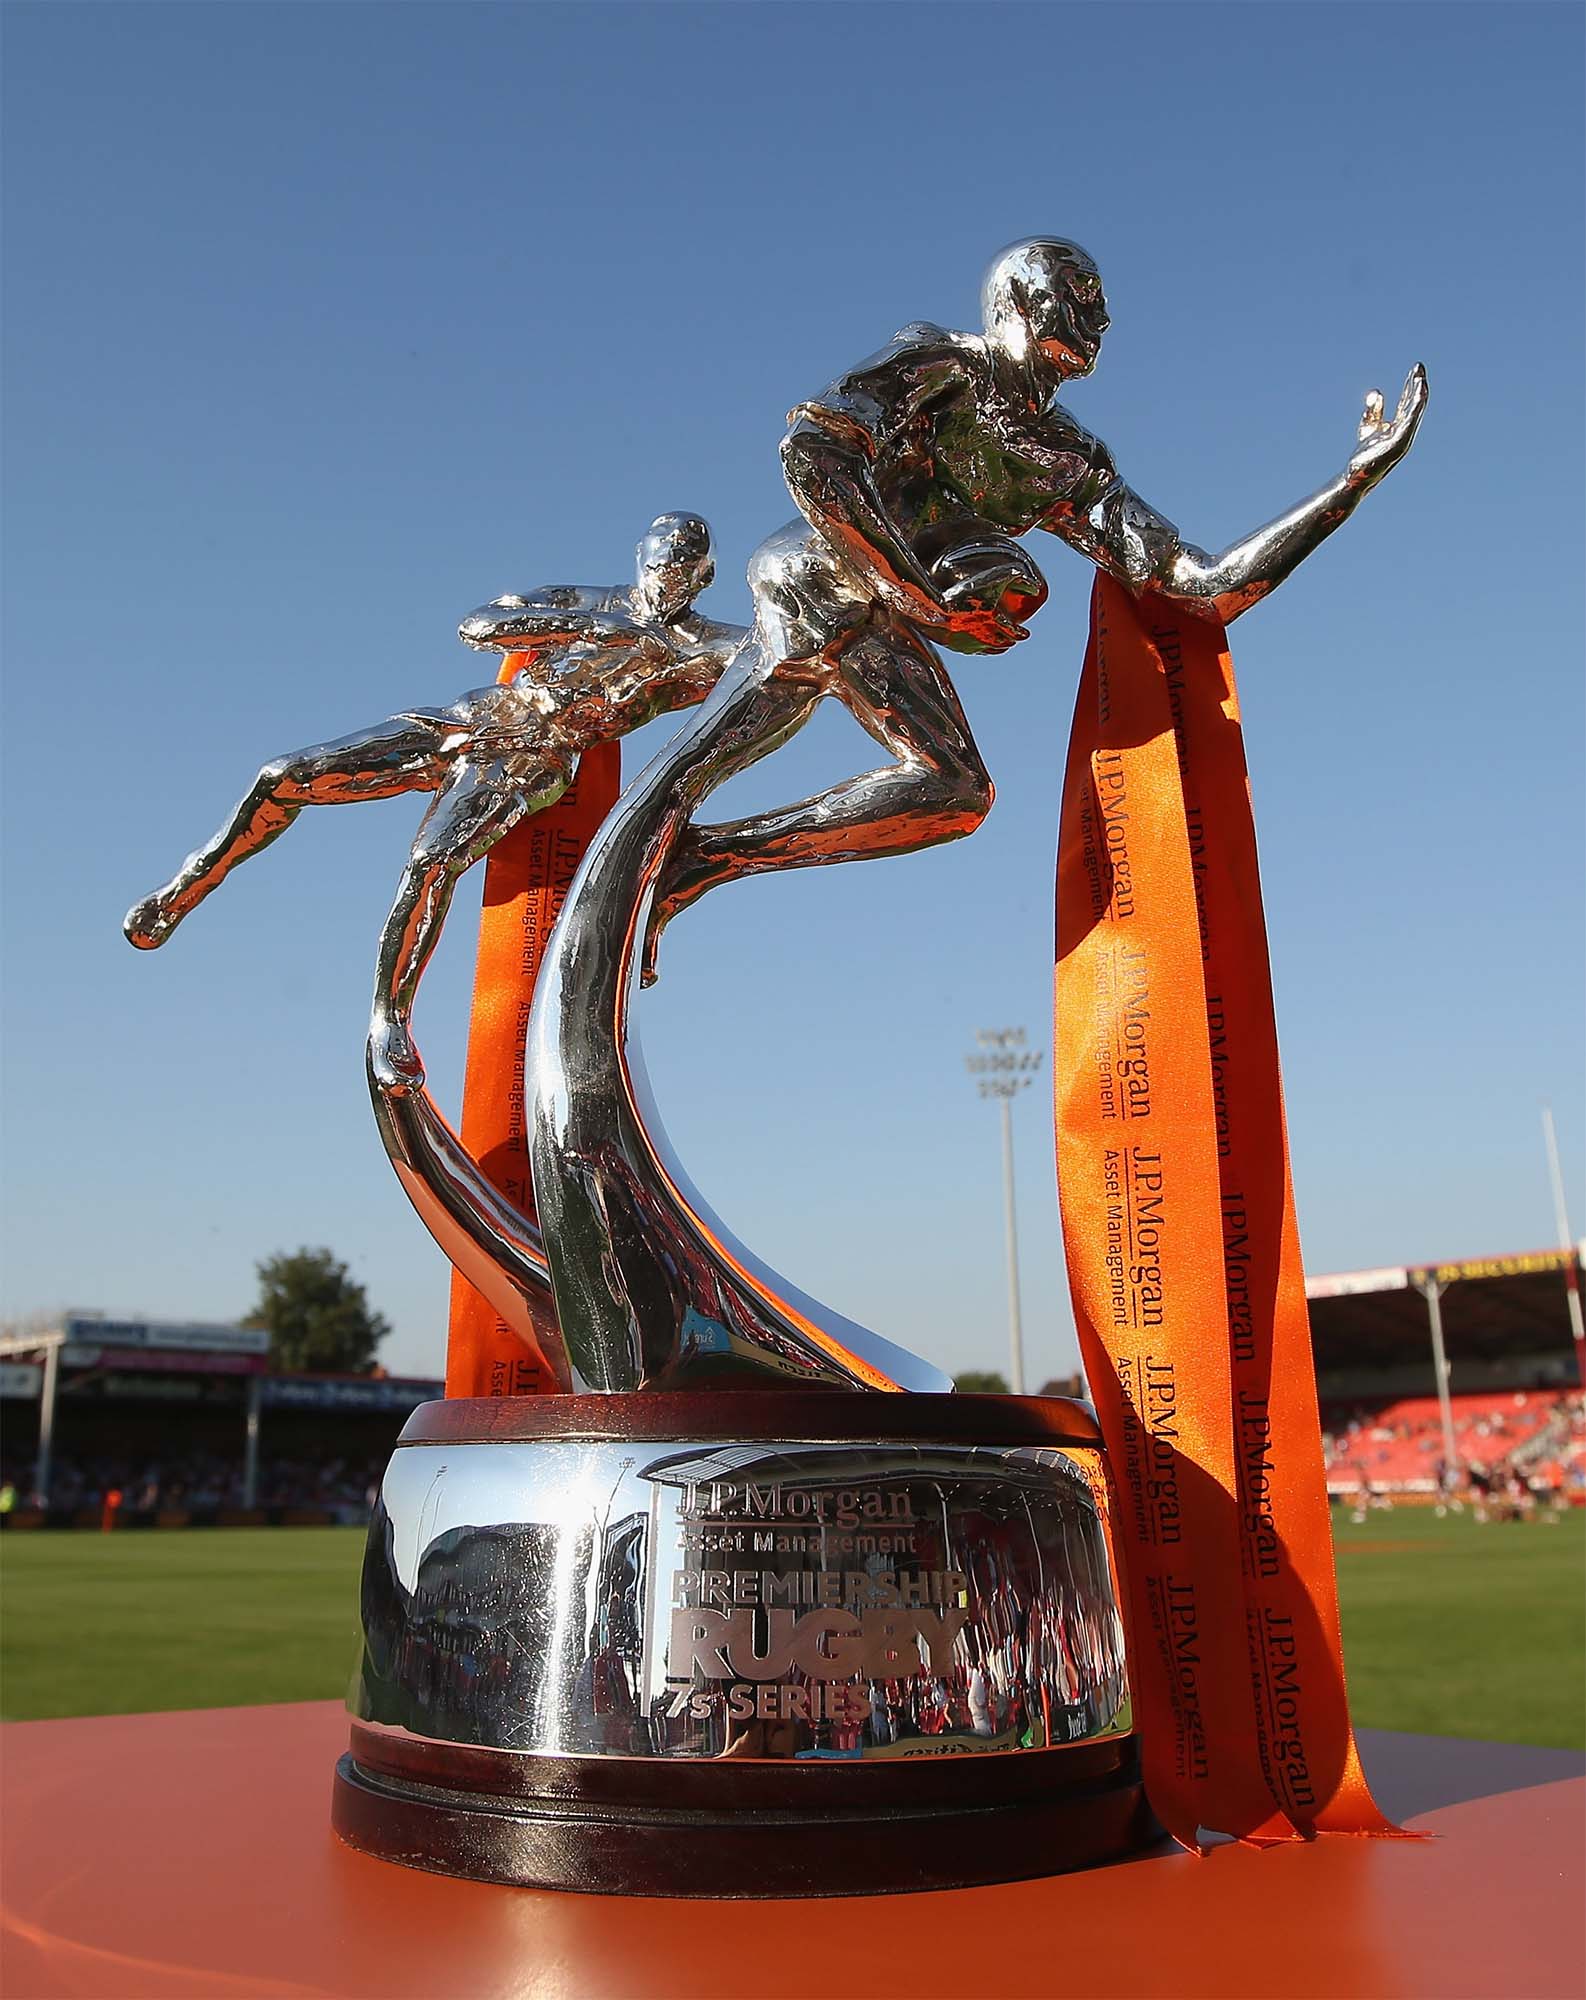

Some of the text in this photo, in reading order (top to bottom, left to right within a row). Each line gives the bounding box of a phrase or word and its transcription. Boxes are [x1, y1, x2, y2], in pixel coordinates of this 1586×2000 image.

[521, 829, 545, 976] Asset Management
[1080, 808, 1107, 921] Management
[1096, 749, 1135, 919] J.P.Morgan
[507, 1048, 526, 1153] Management
[1095, 1003, 1119, 1120] Management
[1117, 945, 1152, 1119] J.P.Morgan
[1104, 1149, 1130, 1327] Asset Management
[1129, 1146, 1164, 1328] J.P.Morgan
[490, 1360, 507, 1395] Asse
[1117, 1357, 1150, 1543] Asset Management
[1146, 1355, 1182, 1545] J.P.Morgan
[675, 1480, 914, 1529] J.P.Morgan
[677, 1530, 917, 1553] Asset Management
[1238, 1391, 1281, 1578] J.P.Morgan
[666, 1607, 970, 1681] RUGBY
[671, 1569, 969, 1605] PREMIERSHIP
[666, 1684, 873, 1720] 7s SERIES
[1166, 1575, 1209, 1779] J.P.Morgan
[1265, 1607, 1317, 1807] J.P.Morgan
